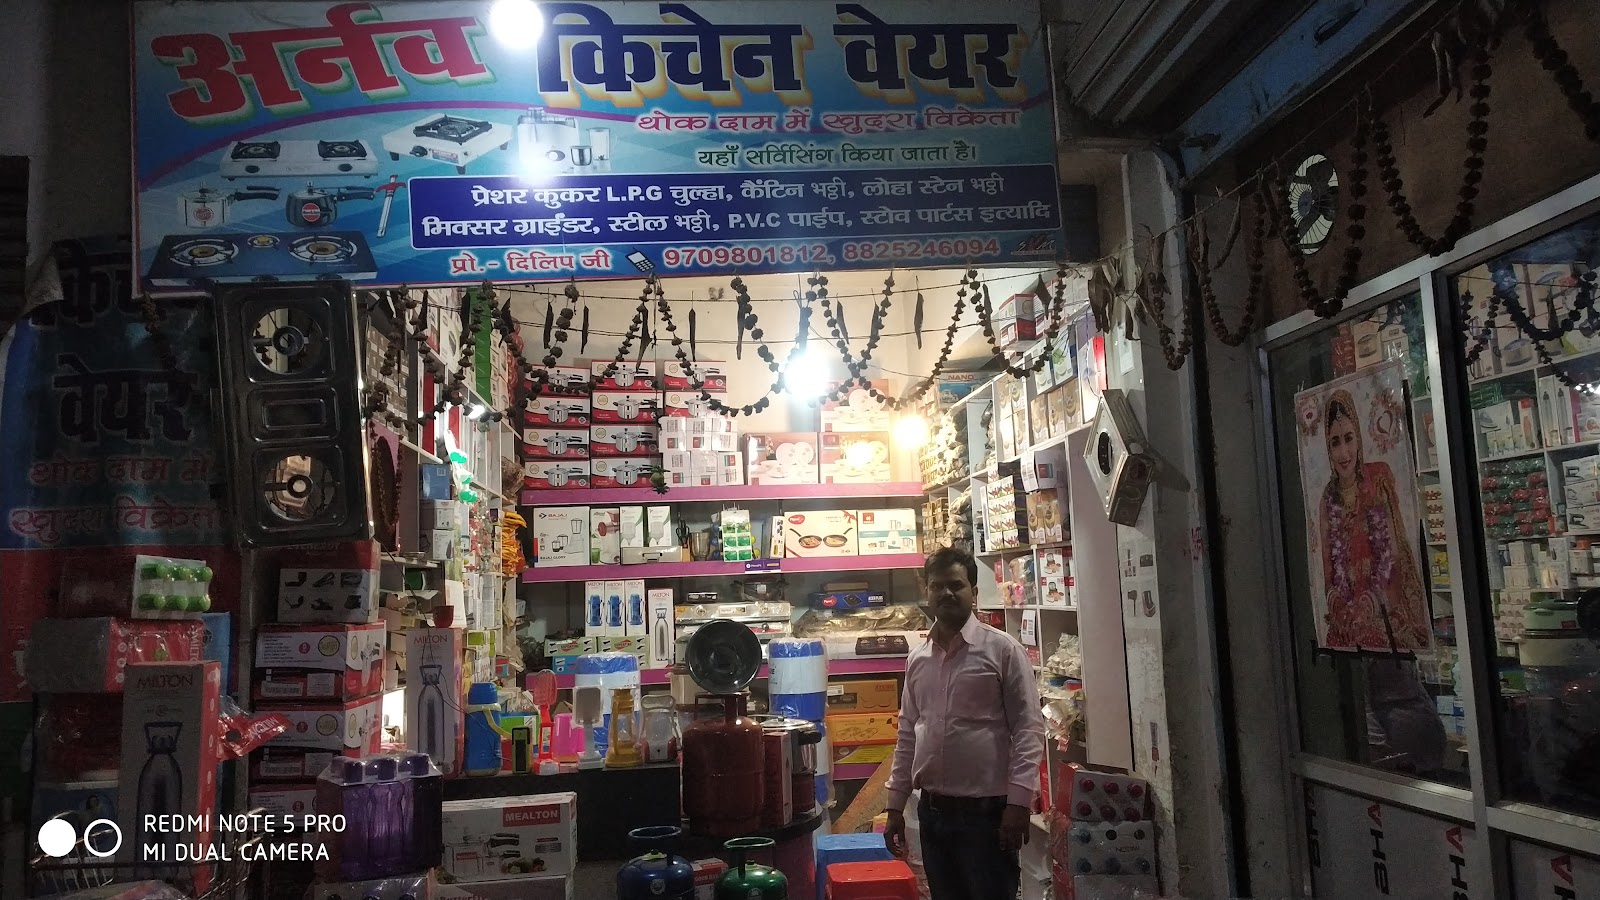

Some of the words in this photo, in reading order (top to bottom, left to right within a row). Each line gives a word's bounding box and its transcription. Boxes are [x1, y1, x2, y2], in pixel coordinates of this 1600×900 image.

[151, 2, 487, 119] अर्नव
[537, 2, 803, 94] किचेन
[833, 3, 1018, 90] वेयर
[639, 109, 707, 131] थोक
[718, 112, 777, 131] दाम
[785, 107, 811, 130] में
[823, 112, 914, 135] खुदरा
[925, 106, 1020, 130] विक्रेता
[698, 143, 738, 166] यहाँ
[746, 142, 834, 165] सर्विसिंग
[842, 143, 894, 162] किया
[901, 145, 948, 162] जाता
[471, 184, 528, 207] प्रेशर
[533, 187, 601, 209] कुकर
[606, 185, 663, 202] L.P.G
[669, 184, 733, 206] चुल्हा,
[740, 179, 804, 199] कैंटिन
[861, 177, 912, 196] लोहा
[919, 175, 964, 194] स्टेन
[422, 215, 508, 237] मिक्सर
[608, 212, 669, 233] स्टील
[728, 212, 780, 229] P.V.C
[787, 206, 853, 228] पाईप,
[860, 206, 911, 225] स्टोव
[916, 202, 973, 223] पार्टस
[978, 200, 1051, 223] इत्यादि
[506, 251, 575, 271] दिलिप
[581, 249, 612, 269] जी
[663, 244, 834, 267] 9709801812,
[843, 238, 999, 261] 8825246094
[53, 352, 199, 443] वेयर
[30, 455, 99, 484] थोक
[106, 456, 172, 483] दाम
[190, 631, 200, 662] MILTO
[413, 634, 448, 645] MILTON
[136, 673, 193, 690] MILTON
[505, 809, 558, 823] MEALTON
